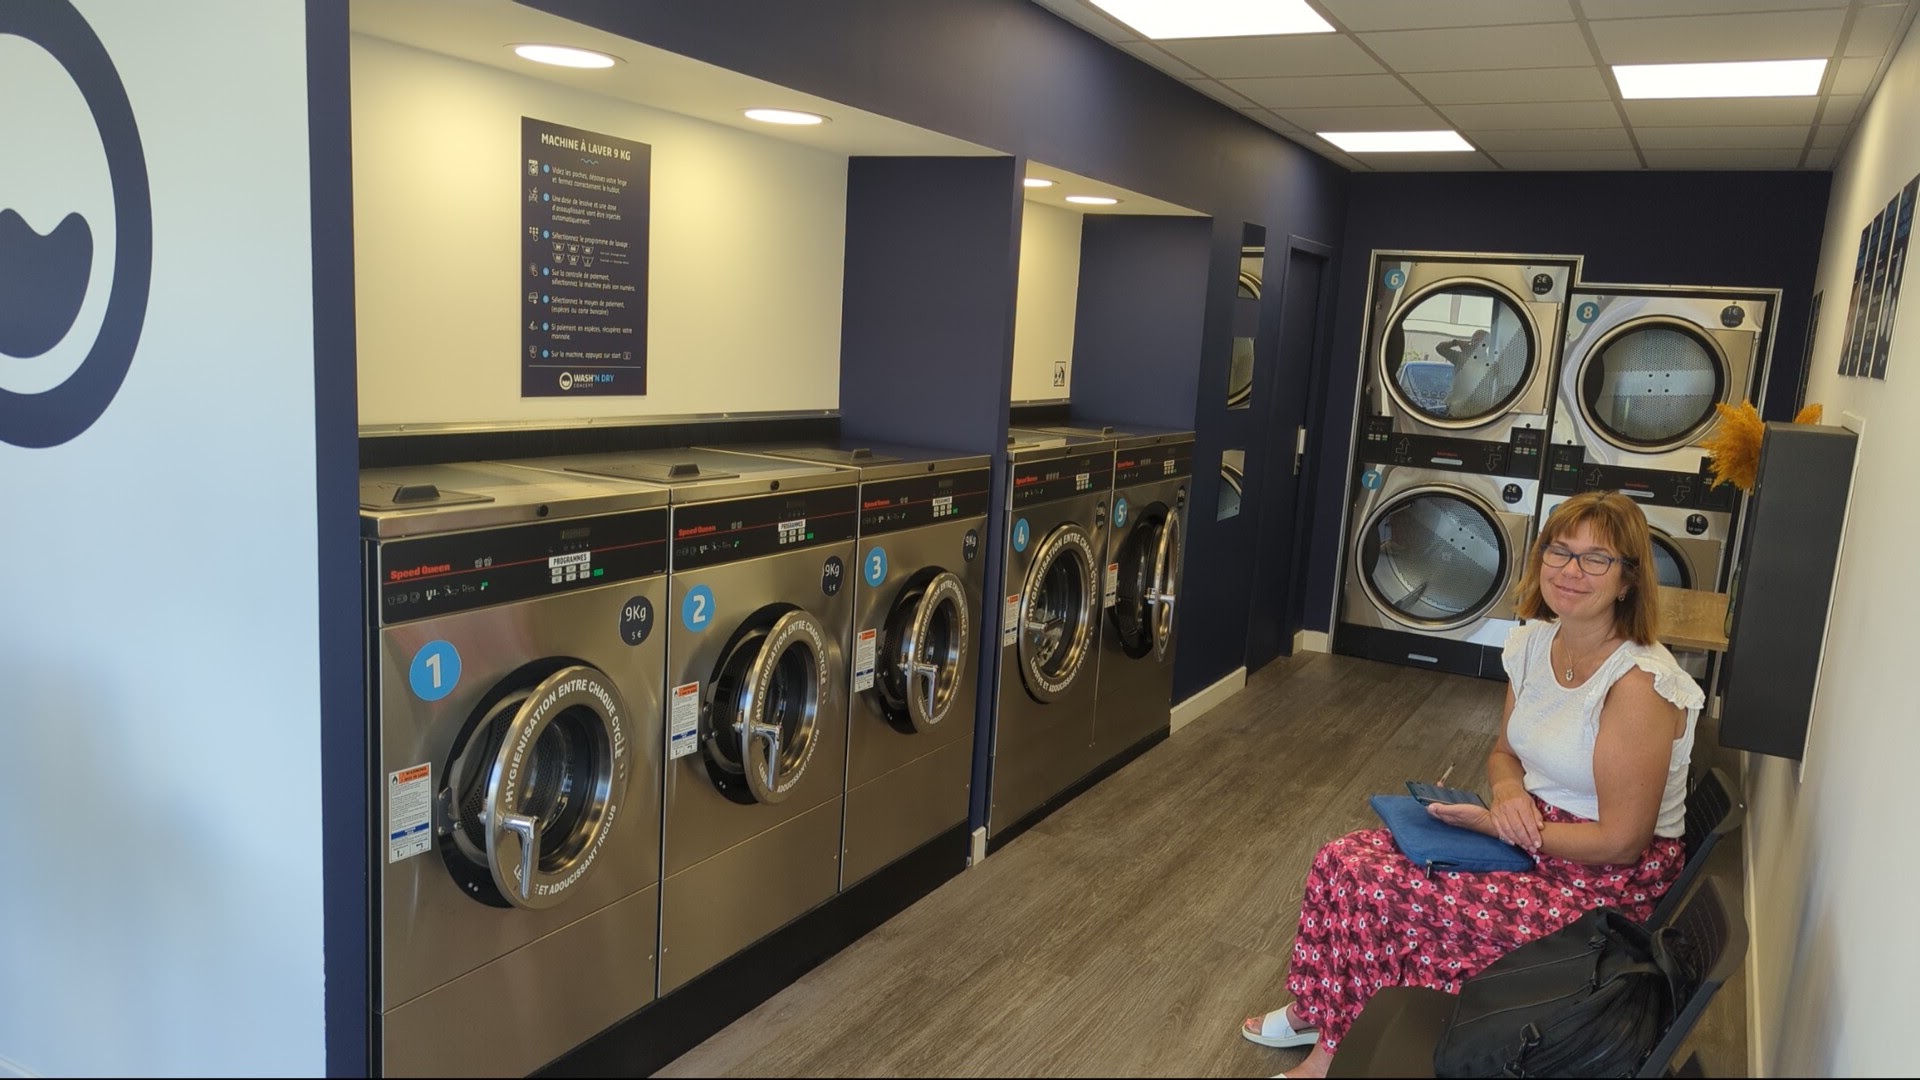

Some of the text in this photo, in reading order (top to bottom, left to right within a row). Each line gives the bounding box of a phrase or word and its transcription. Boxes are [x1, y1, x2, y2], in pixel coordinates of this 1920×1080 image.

[542, 133, 631, 161] MACHINE À LAVER 9 KG
[1390, 274, 1399, 286] 6
[1537, 276, 1547, 284] 2€
[1584, 307, 1592, 319] 8
[573, 374, 614, 382] WASH'N DRY
[1367, 475, 1377, 487] 7
[1118, 505, 1124, 522] 5
[1692, 516, 1702, 524] 1€
[678, 525, 716, 537] Speed Queen
[781, 521, 804, 530] PROGRAMMES
[966, 536, 977, 547] 9Kg
[1018, 527, 1024, 545] 4
[1063, 533, 1080, 544] ENTRE
[1080, 534, 1095, 568] CHAQUE
[553, 553, 587, 566] PROGRAMMES
[390, 563, 451, 581] Speed Queen
[825, 563, 840, 577] 9Kg
[873, 556, 881, 579] 3
[625, 604, 647, 622] 9Kg
[693, 594, 706, 624] 2
[631, 630, 642, 639] 5 €
[426, 653, 441, 689] 1
[756, 631, 788, 720] HYGIENISATION
[787, 620, 805, 636] ENTRE
[805, 621, 824, 650] CHAQUE
[1043, 681, 1049, 691] ET
[505, 692, 556, 803] HYGIENISATION
[557, 679, 587, 698] ENTRE
[588, 680, 616, 721] CHAQUE
[611, 709, 623, 760] CYCLE
[538, 883, 549, 896] ET
[549, 847, 598, 895] ADOUCISSANT
[598, 805, 617, 847] INCLUS
